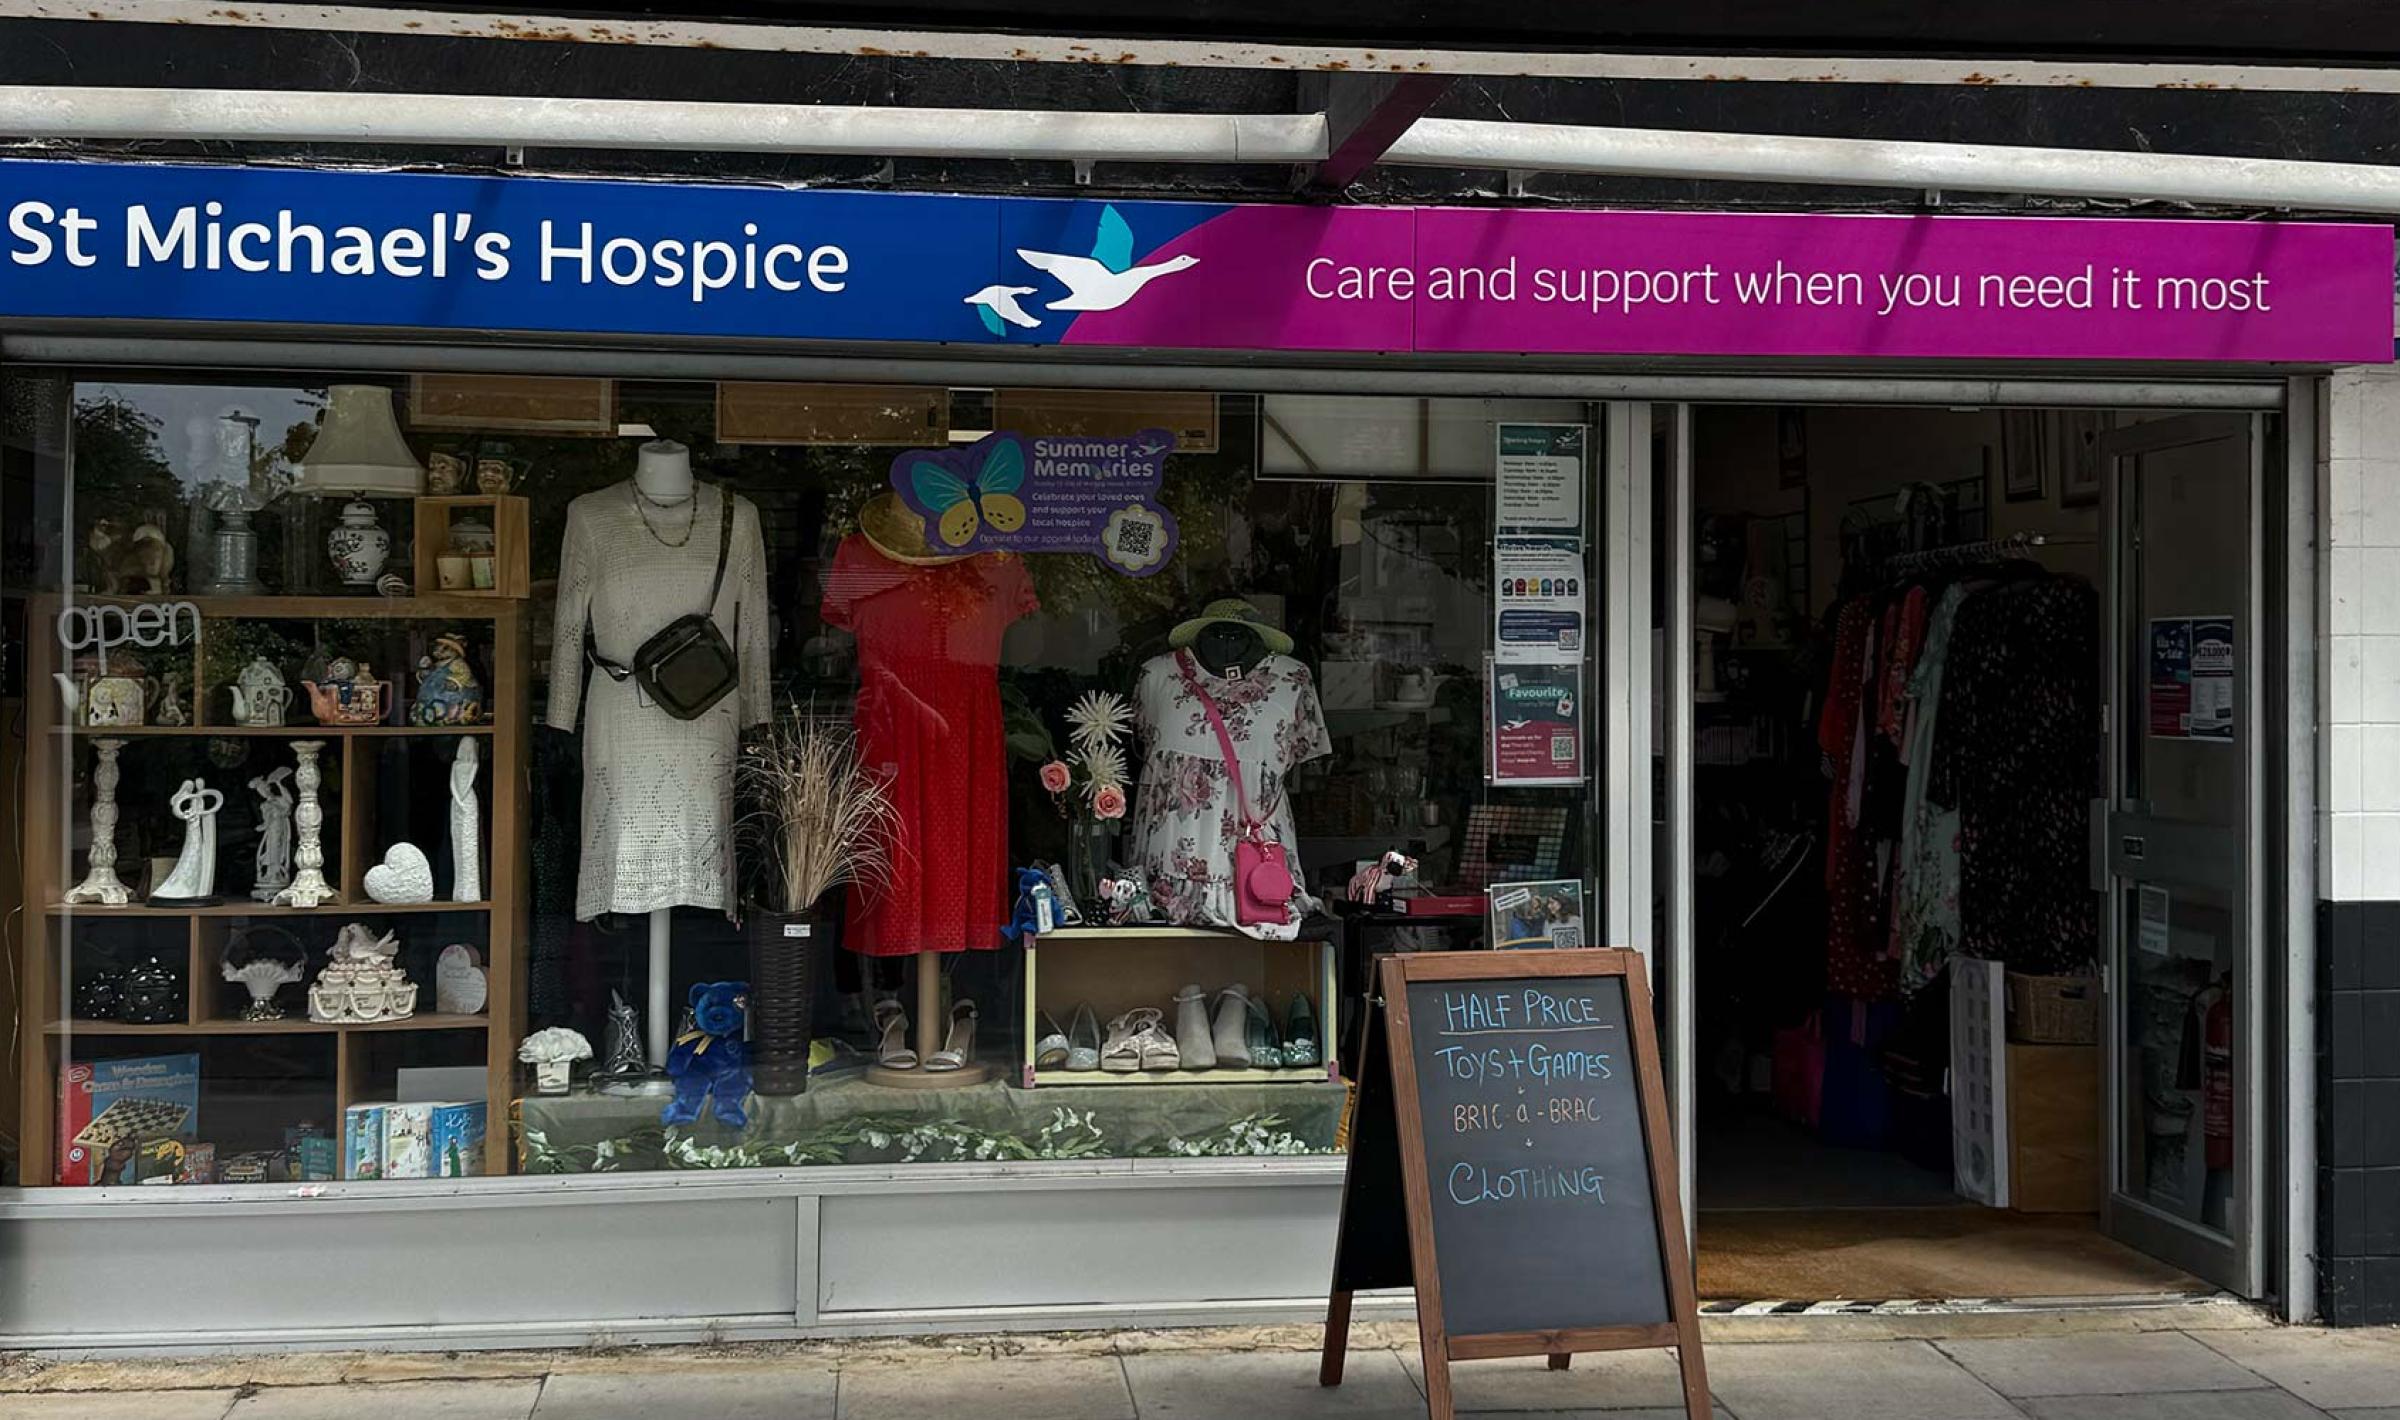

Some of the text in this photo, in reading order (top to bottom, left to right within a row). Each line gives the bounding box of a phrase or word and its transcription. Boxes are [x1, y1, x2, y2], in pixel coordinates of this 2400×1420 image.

[8, 201, 98, 267] St
[540, 219, 850, 303] Hospice
[1305, 256, 2272, 315] Care and support when you need it most
[1033, 440, 1128, 458] Summer
[1032, 492, 1145, 503] Celebrate your loved ones
[1032, 506, 1107, 516] and support your
[1032, 518, 1091, 529] local hospice
[57, 601, 202, 677] open
[1444, 989, 1601, 1032] HALF PRICE
